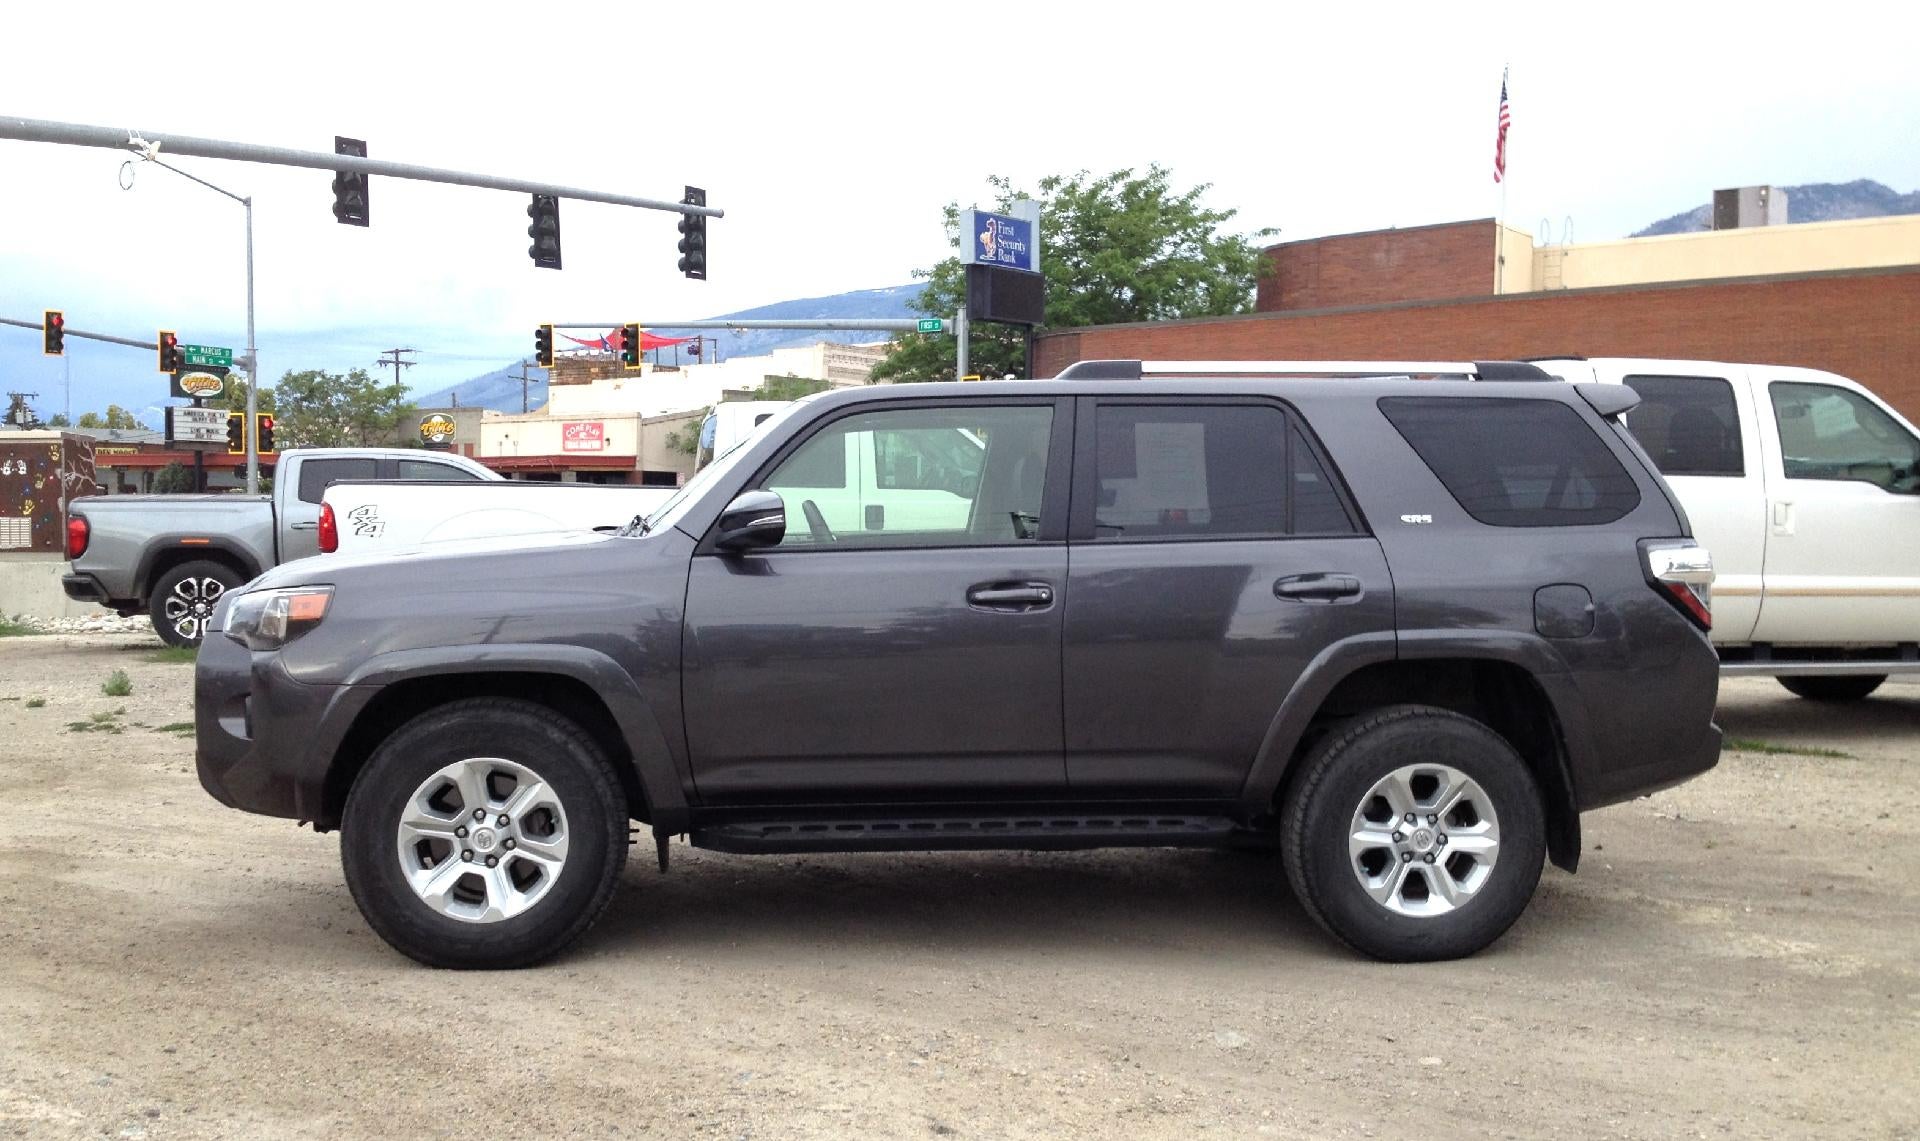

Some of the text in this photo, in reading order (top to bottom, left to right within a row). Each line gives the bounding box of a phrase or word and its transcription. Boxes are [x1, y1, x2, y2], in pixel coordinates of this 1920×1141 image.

[997, 220, 1014, 236] First
[997, 234, 1026, 255] Security
[997, 248, 1016, 264] Bank
[920, 321, 933, 329] FIRST
[200, 345, 222, 356] MARCUS
[192, 355, 206, 363] MAIN
